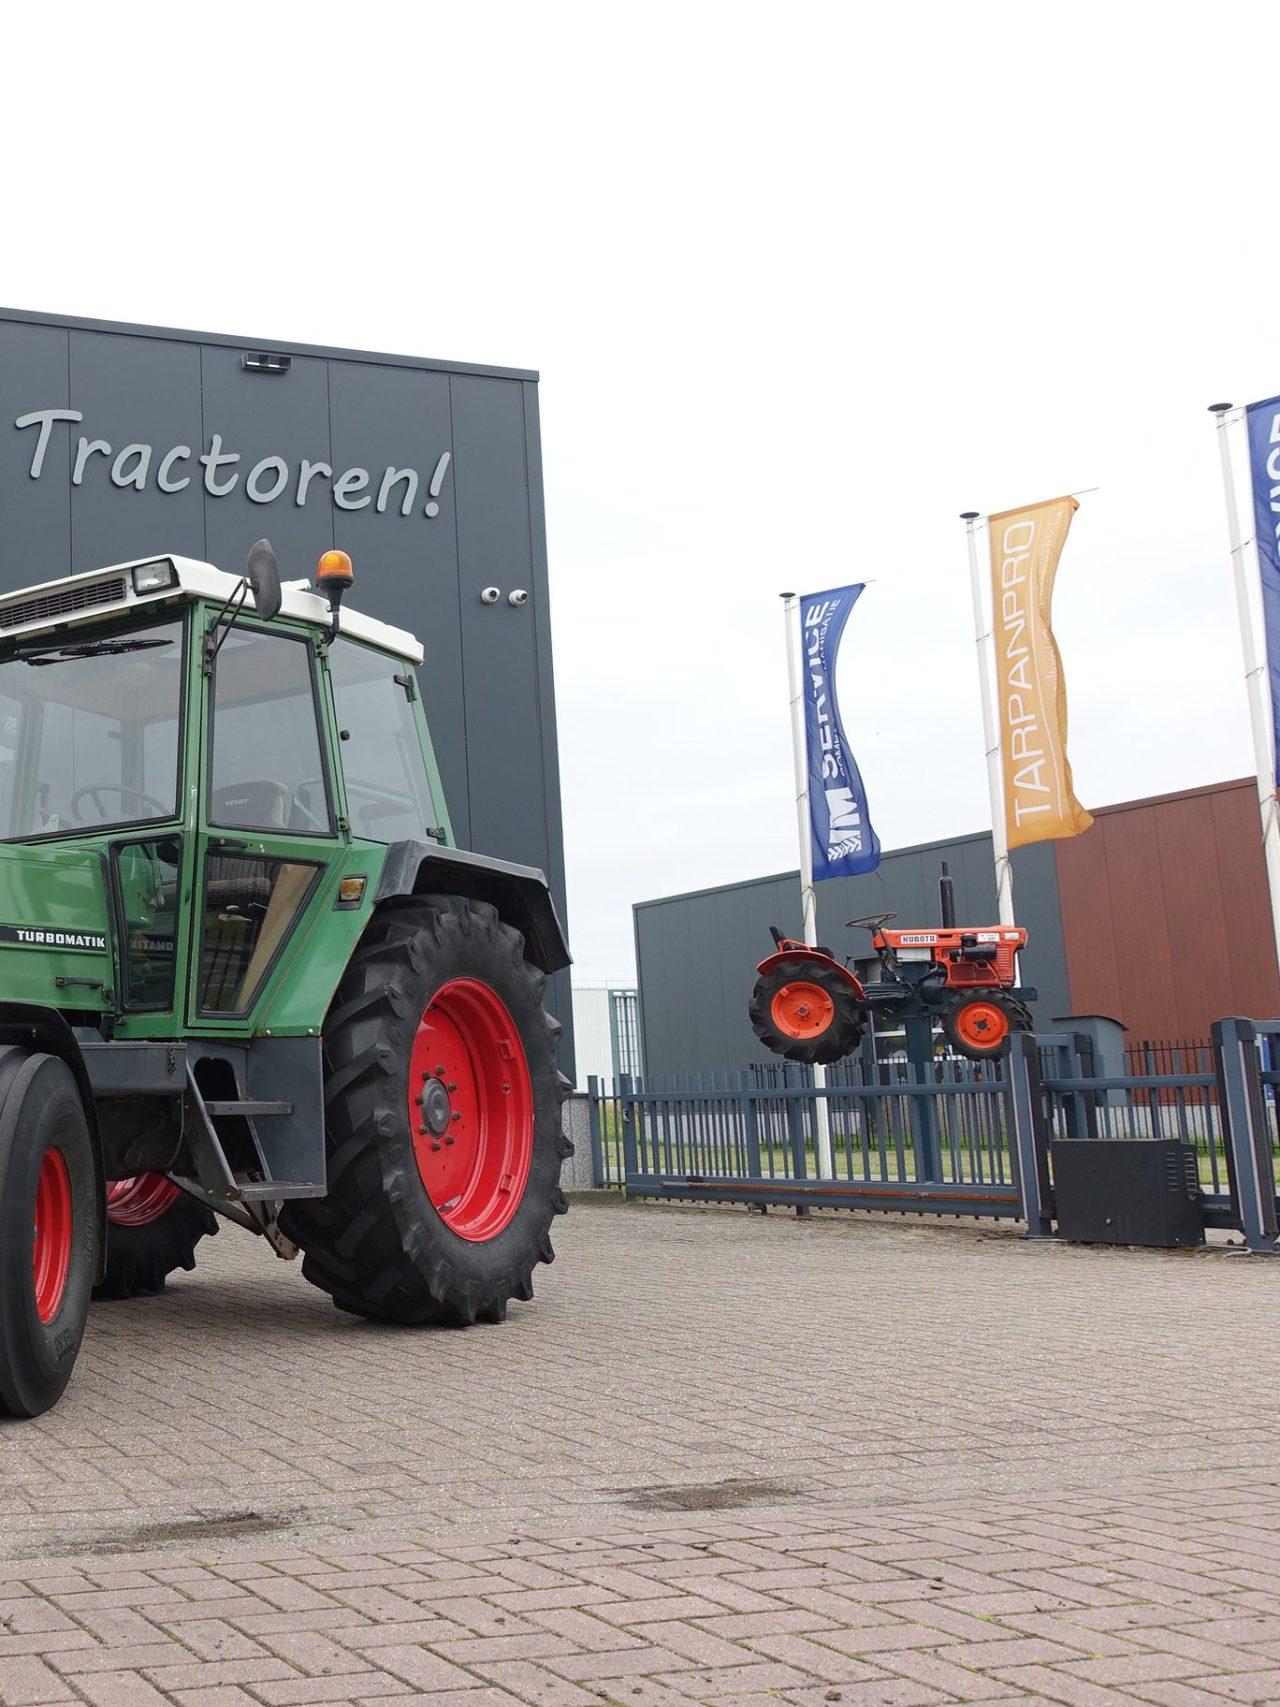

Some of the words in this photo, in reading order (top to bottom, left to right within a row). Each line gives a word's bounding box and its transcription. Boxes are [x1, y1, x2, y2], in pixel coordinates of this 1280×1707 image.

[16, 410, 451, 517] Tractoren!
[1001, 519, 1052, 828] TARPANPRO
[16, 930, 105, 948] TURBOMATIK
[902, 934, 936, 943] KUBOTA
